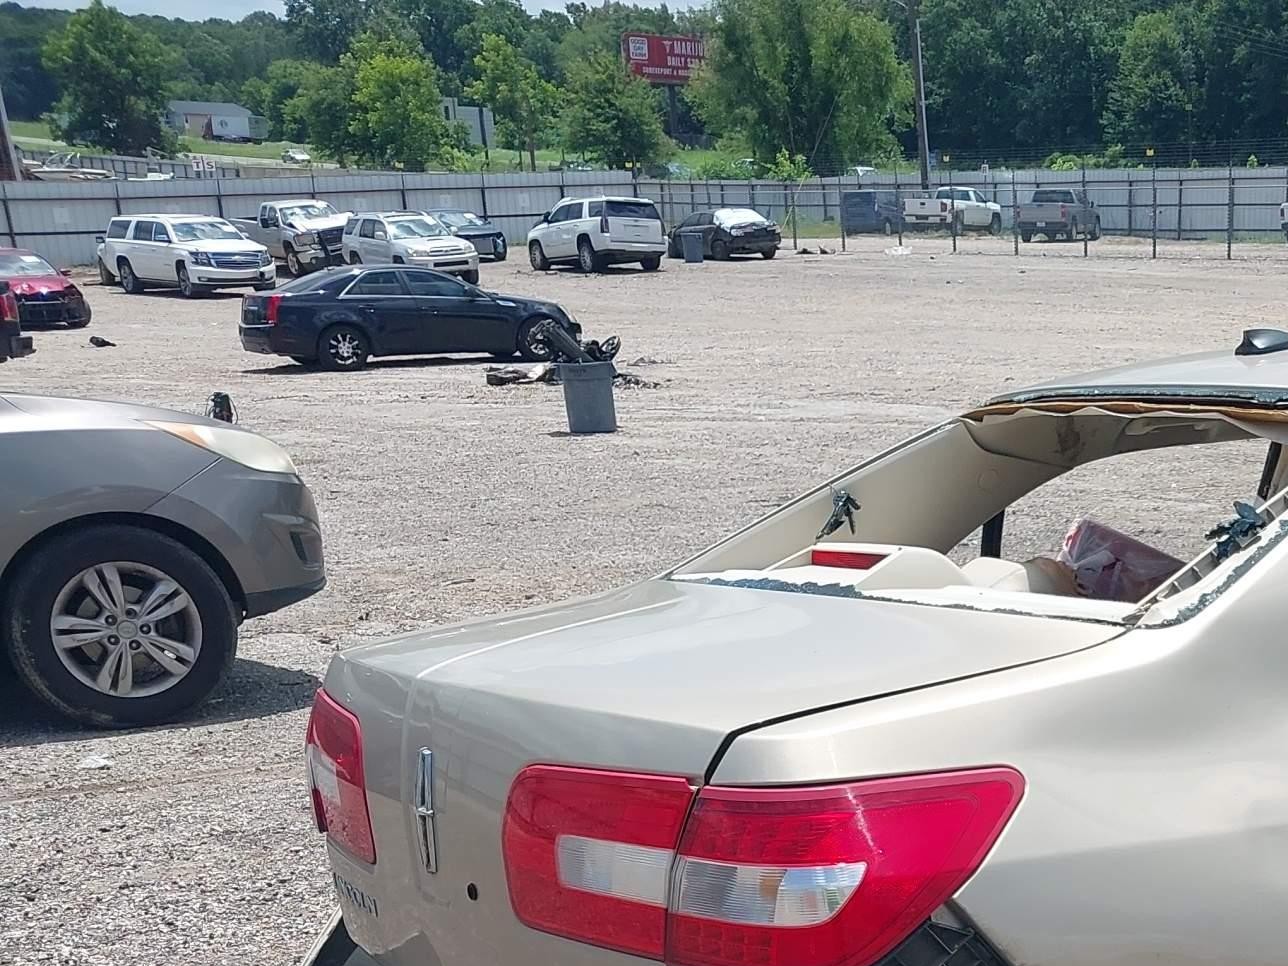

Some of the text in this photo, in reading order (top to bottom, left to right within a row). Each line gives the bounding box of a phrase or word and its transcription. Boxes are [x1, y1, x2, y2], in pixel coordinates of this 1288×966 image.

[667, 55, 685, 67] DAILY
[193, 161, 201, 169] T
[206, 161, 215, 169] S
